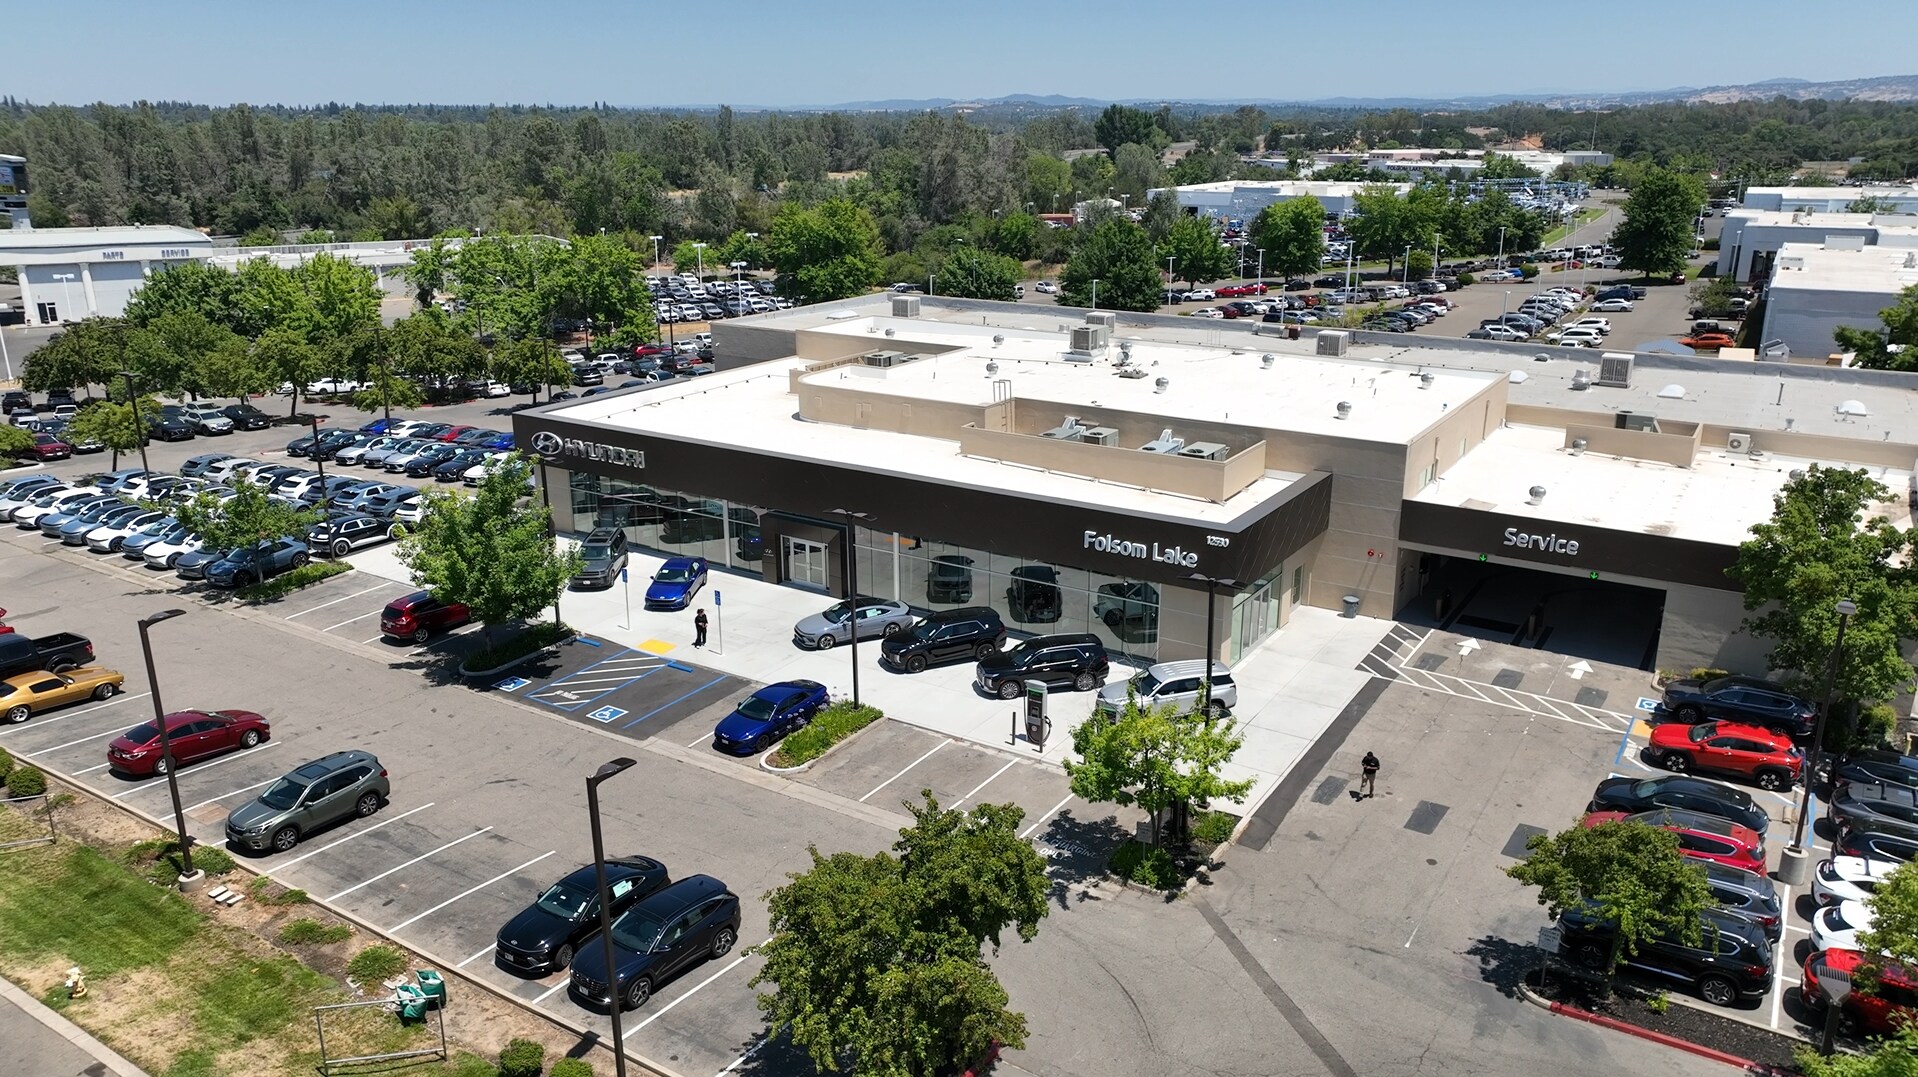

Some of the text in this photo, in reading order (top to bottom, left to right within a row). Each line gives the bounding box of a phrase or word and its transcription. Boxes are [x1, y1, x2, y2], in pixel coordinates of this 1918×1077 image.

[102, 251, 124, 260] PARTS
[161, 248, 190, 258] SERVICE
[564, 438, 646, 469] HYUNDAI
[1083, 530, 1198, 569] Folsom Lake
[1503, 527, 1580, 556] Service
